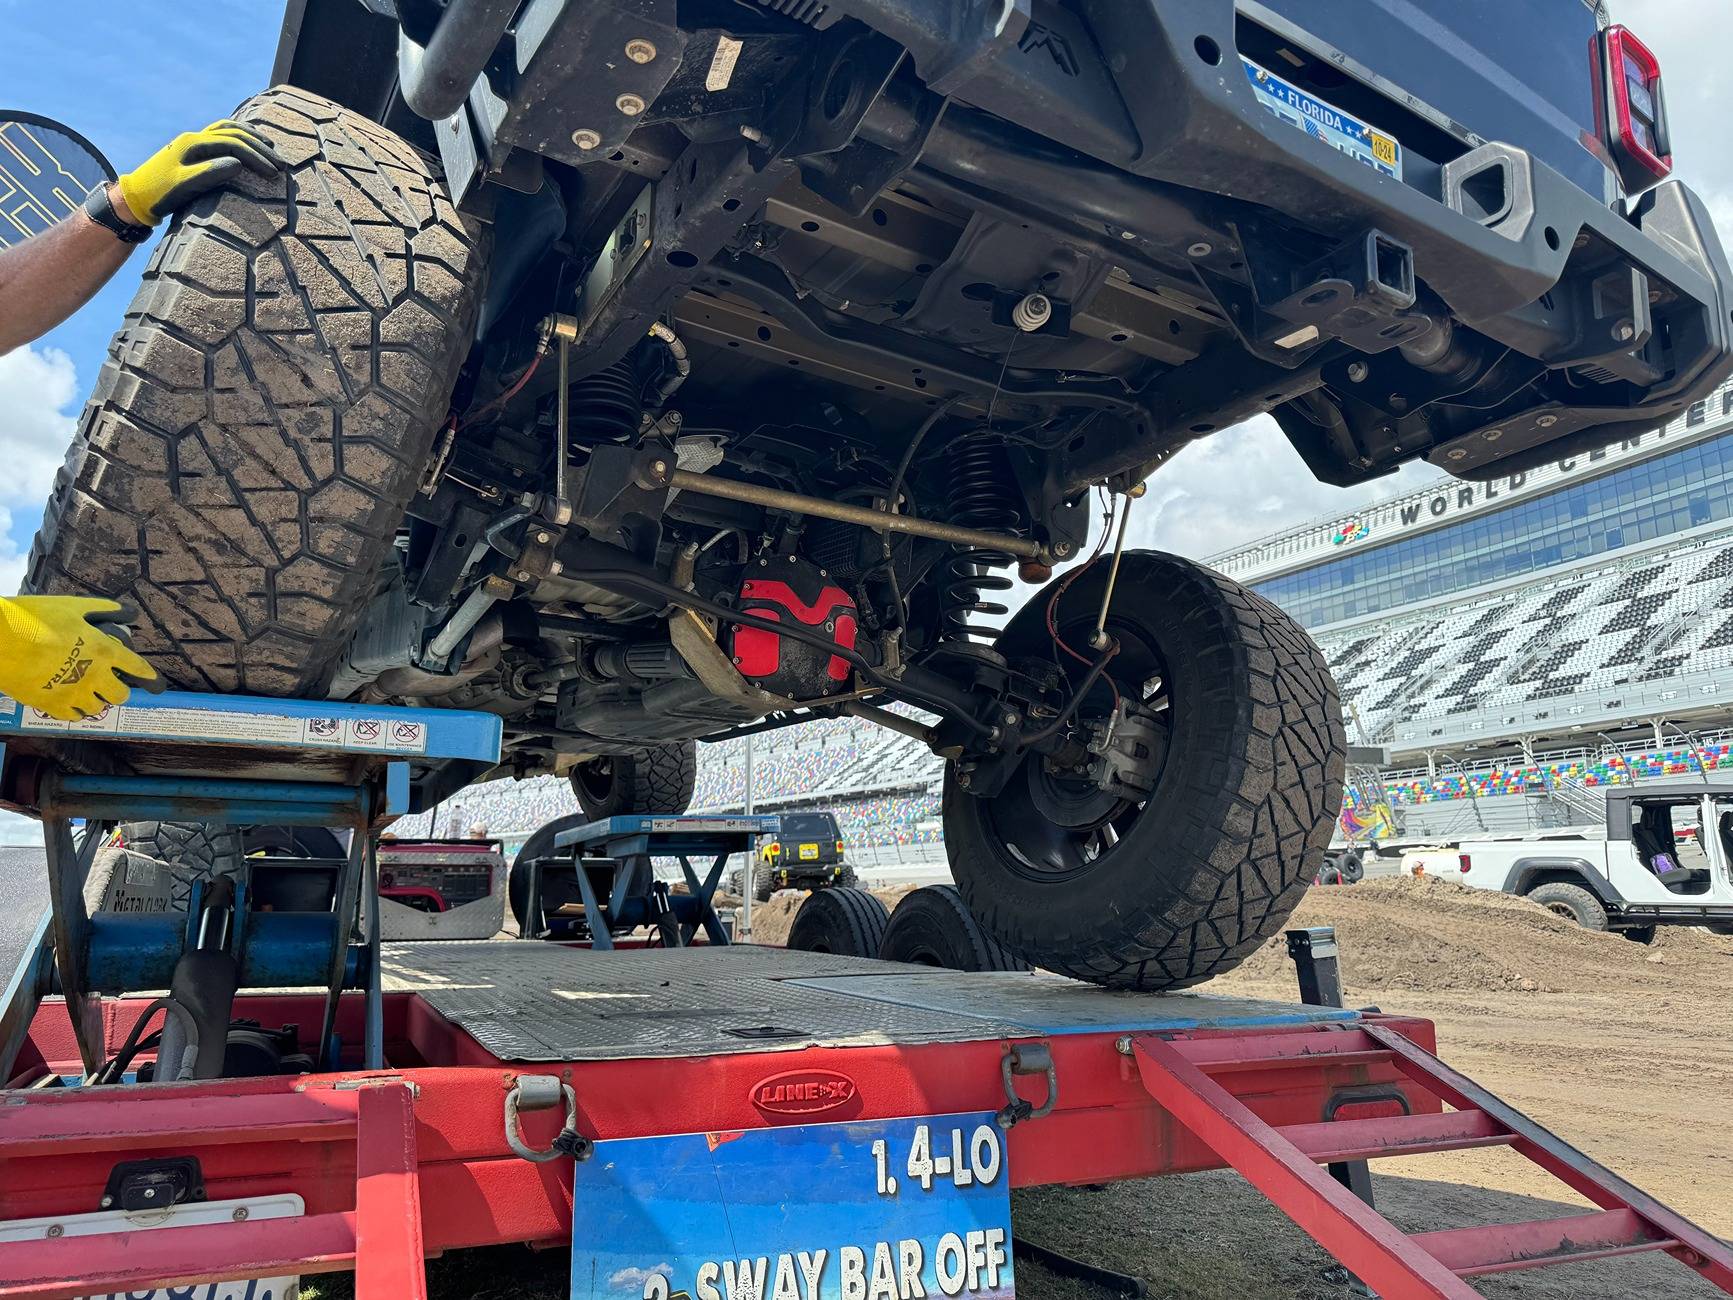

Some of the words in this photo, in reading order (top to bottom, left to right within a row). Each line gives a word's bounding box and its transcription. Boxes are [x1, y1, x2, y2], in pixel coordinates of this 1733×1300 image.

[1287, 90, 1344, 132] FLORIDA
[1374, 138, 1392, 163] 10-24
[1400, 472, 1527, 526] WORLD
[42, 636, 85, 690] ACKTRA
[871, 1139, 898, 1195] 1.
[907, 1125, 1001, 1189] 4-LO
[696, 1248, 829, 1300] SWAY
[839, 1238, 927, 1300] BAR
[934, 1228, 1006, 1295] OFF
